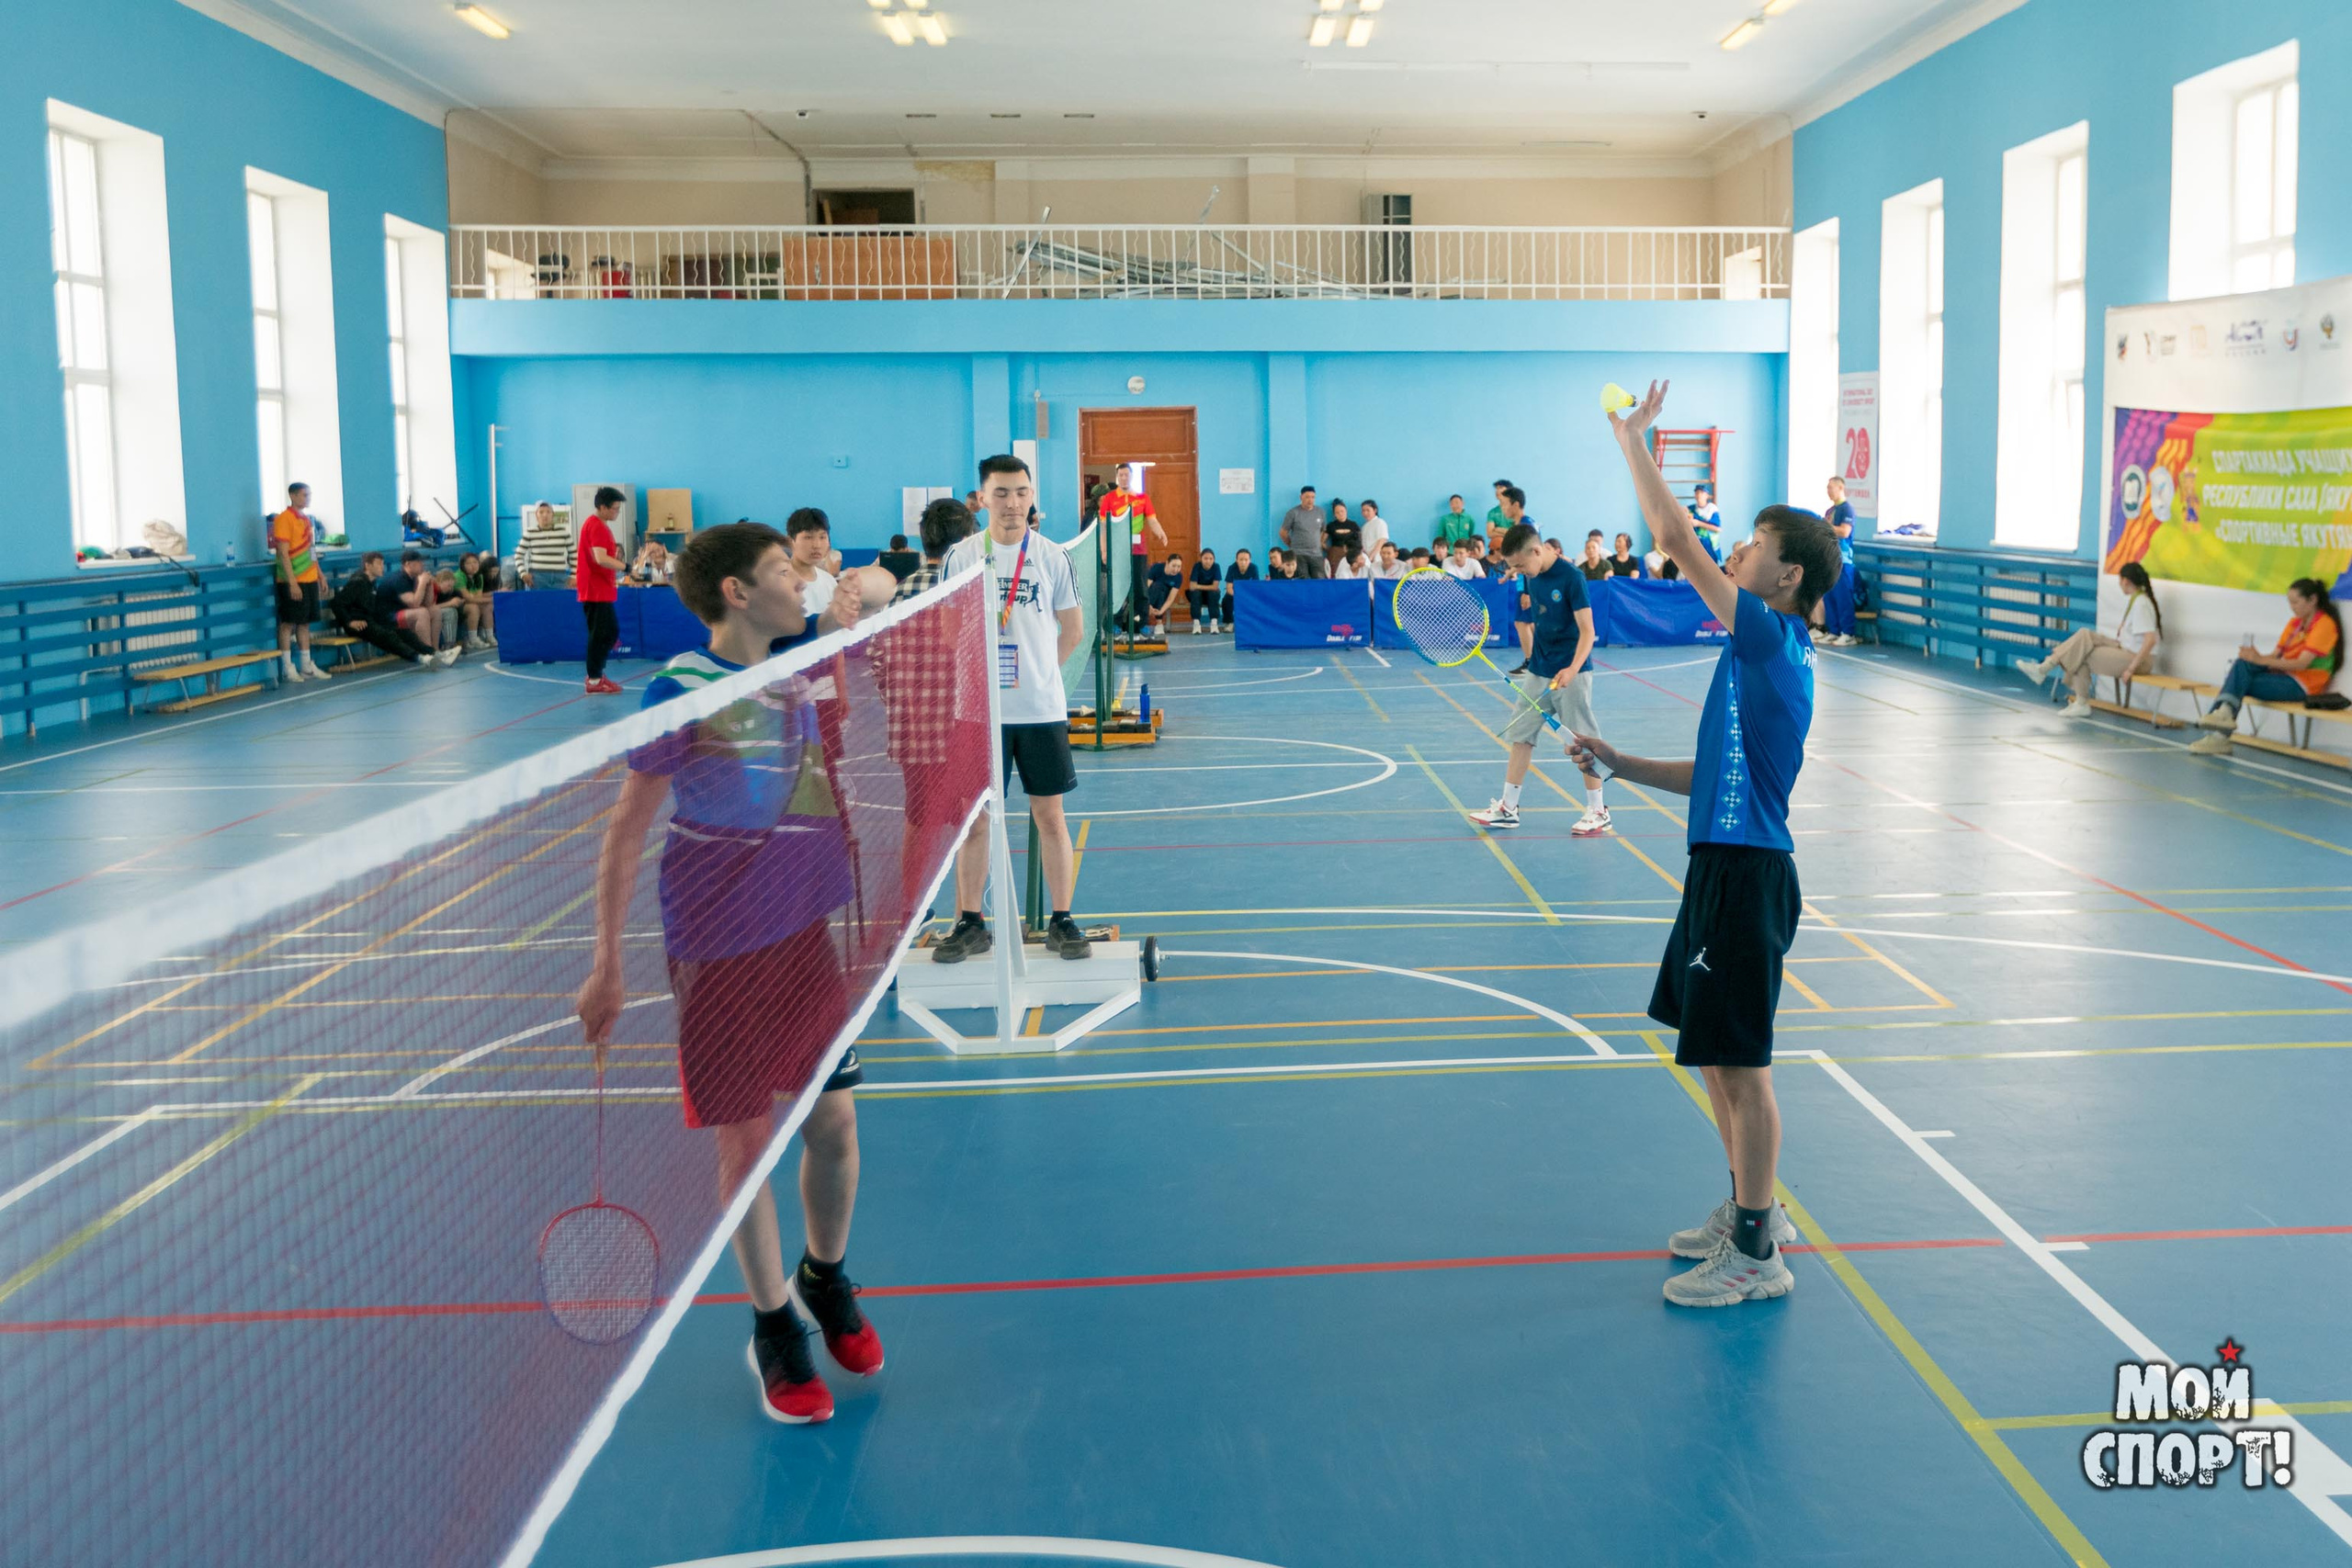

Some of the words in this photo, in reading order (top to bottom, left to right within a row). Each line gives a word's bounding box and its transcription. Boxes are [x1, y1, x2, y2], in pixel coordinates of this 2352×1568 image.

[1845, 427, 1871, 479] 20
[2202, 484, 2284, 509] РЕСПУБЛИКИ
[2285, 485, 2317, 511] САХА
